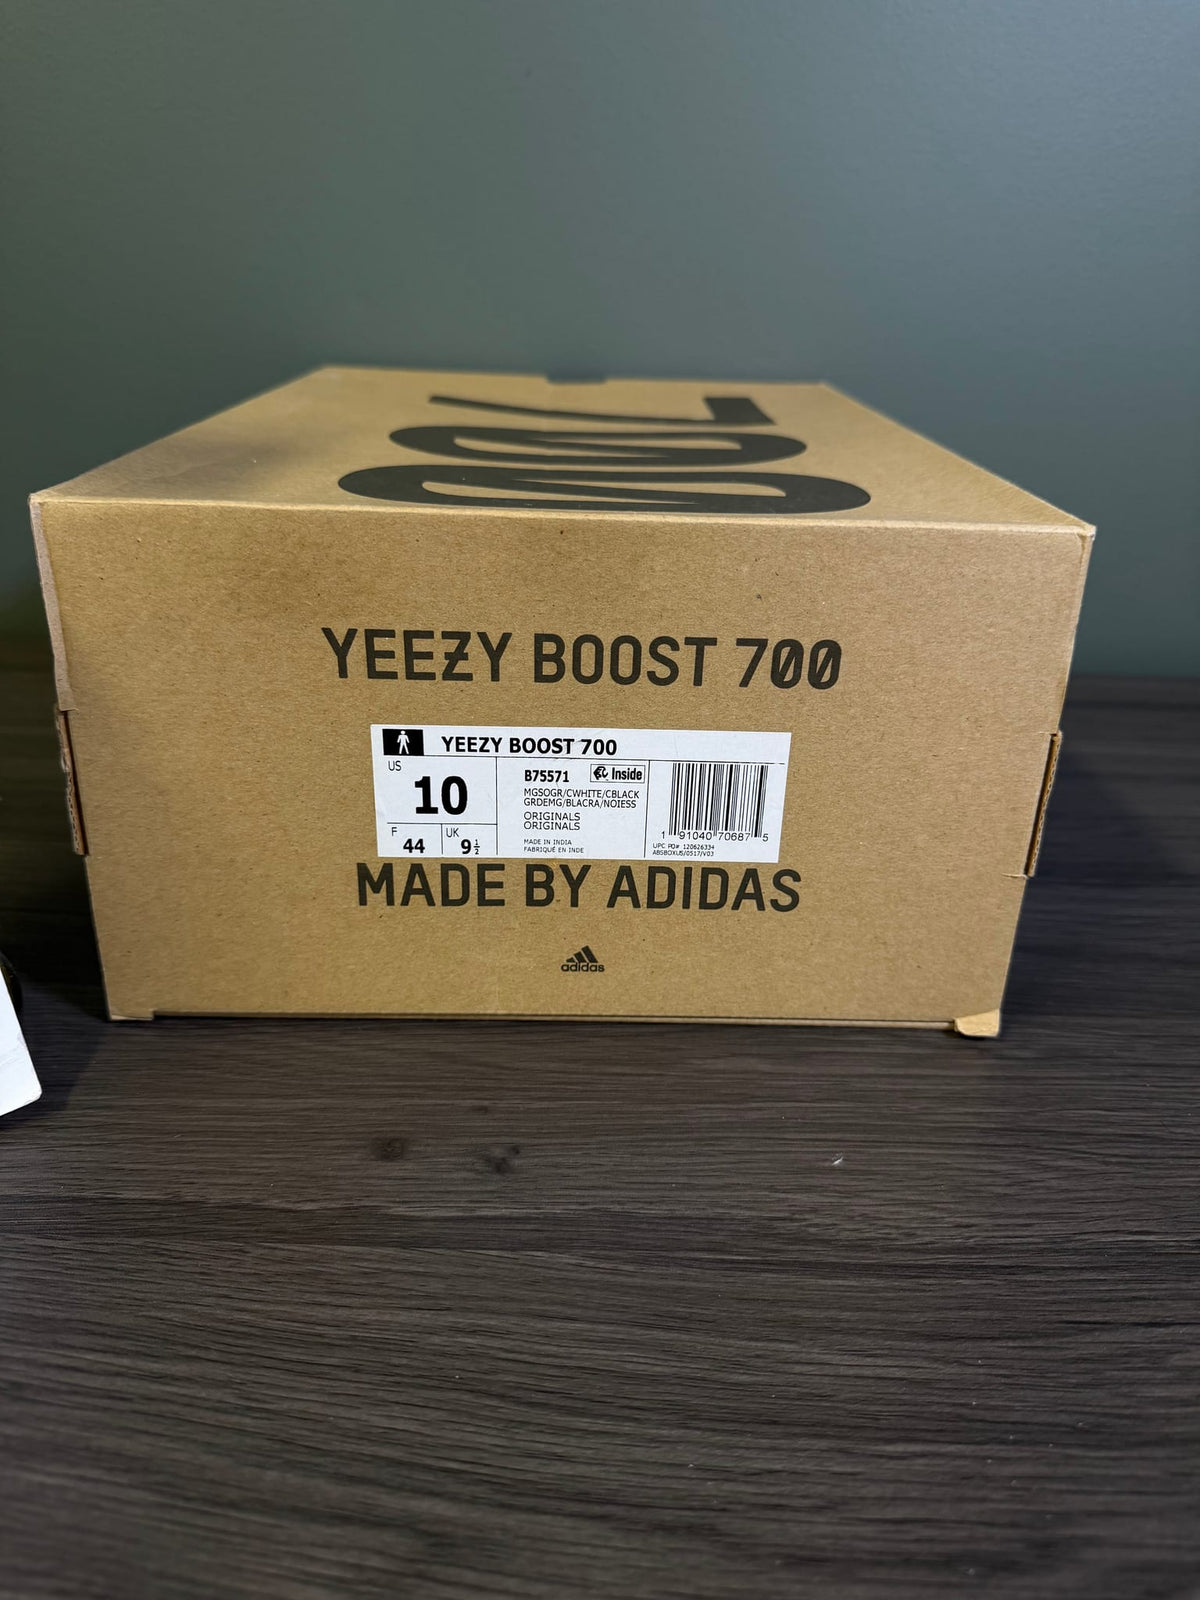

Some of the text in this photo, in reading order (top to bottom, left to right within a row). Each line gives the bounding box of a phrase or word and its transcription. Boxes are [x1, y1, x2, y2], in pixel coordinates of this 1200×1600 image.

[321, 627, 842, 690] YEEZY BOOST 700
[441, 736, 617, 755] YEEZY BOOST 700
[388, 760, 402, 771] US
[524, 769, 570, 782] B75571
[611, 767, 643, 781] Inside
[414, 775, 468, 815] 10
[523, 788, 640, 799] MGSOGR/CWHITE/CBLACK
[523, 798, 637, 809] GRDEMG/BLACRA/NOIESS
[523, 812, 581, 821] ORIGINALS
[523, 821, 581, 831] ORIGINALS
[391, 827, 398, 837] F
[446, 828, 460, 838] UK
[679, 831, 713, 841] 91040
[718, 832, 751, 841] 70687
[762, 833, 769, 842] 5
[403, 838, 426, 854] 44
[523, 845, 556, 854] FABRIQUÉ
[357, 863, 802, 912] MADE BY ADIDAS
[560, 961, 606, 973] adidas
